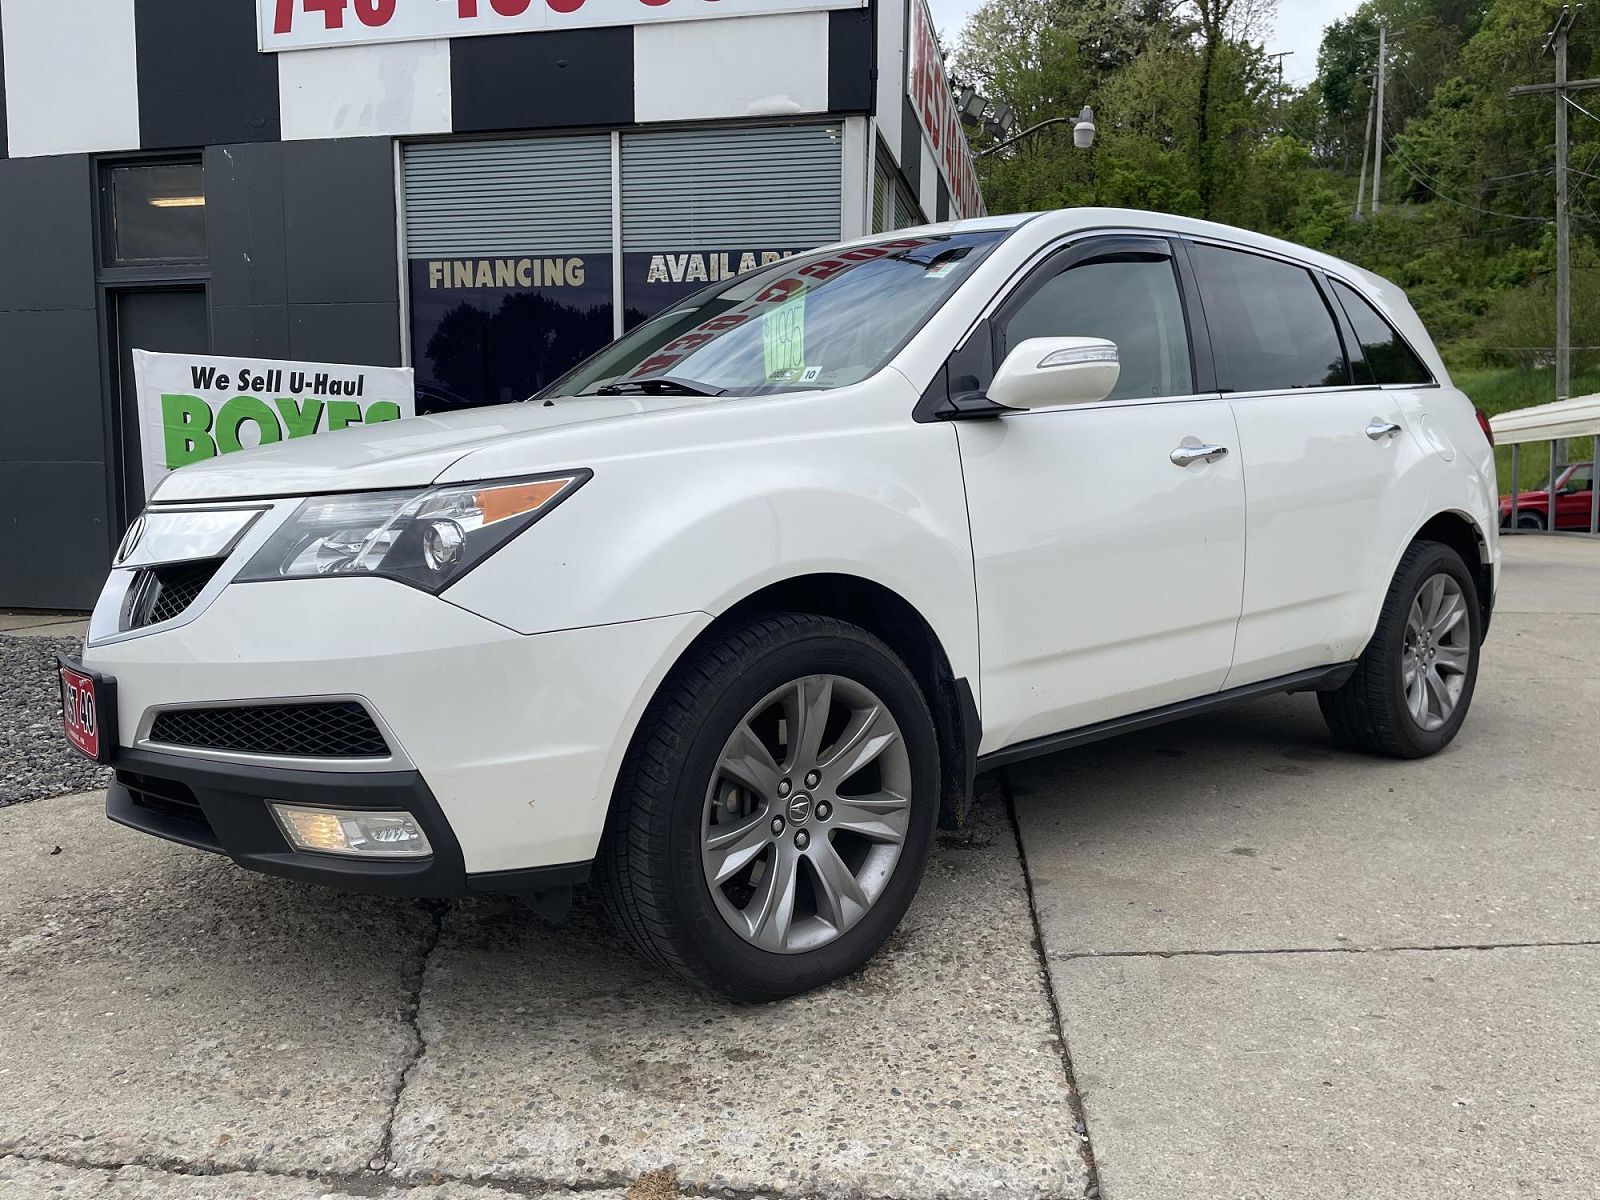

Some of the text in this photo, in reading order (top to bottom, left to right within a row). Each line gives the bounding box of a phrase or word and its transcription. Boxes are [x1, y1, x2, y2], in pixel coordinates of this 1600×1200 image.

[428, 250, 793, 289] FINANCING AVAILA
[190, 366, 366, 397] We Sell U-Haul
[804, 370, 816, 379] 10
[80, 689, 95, 737] 40
